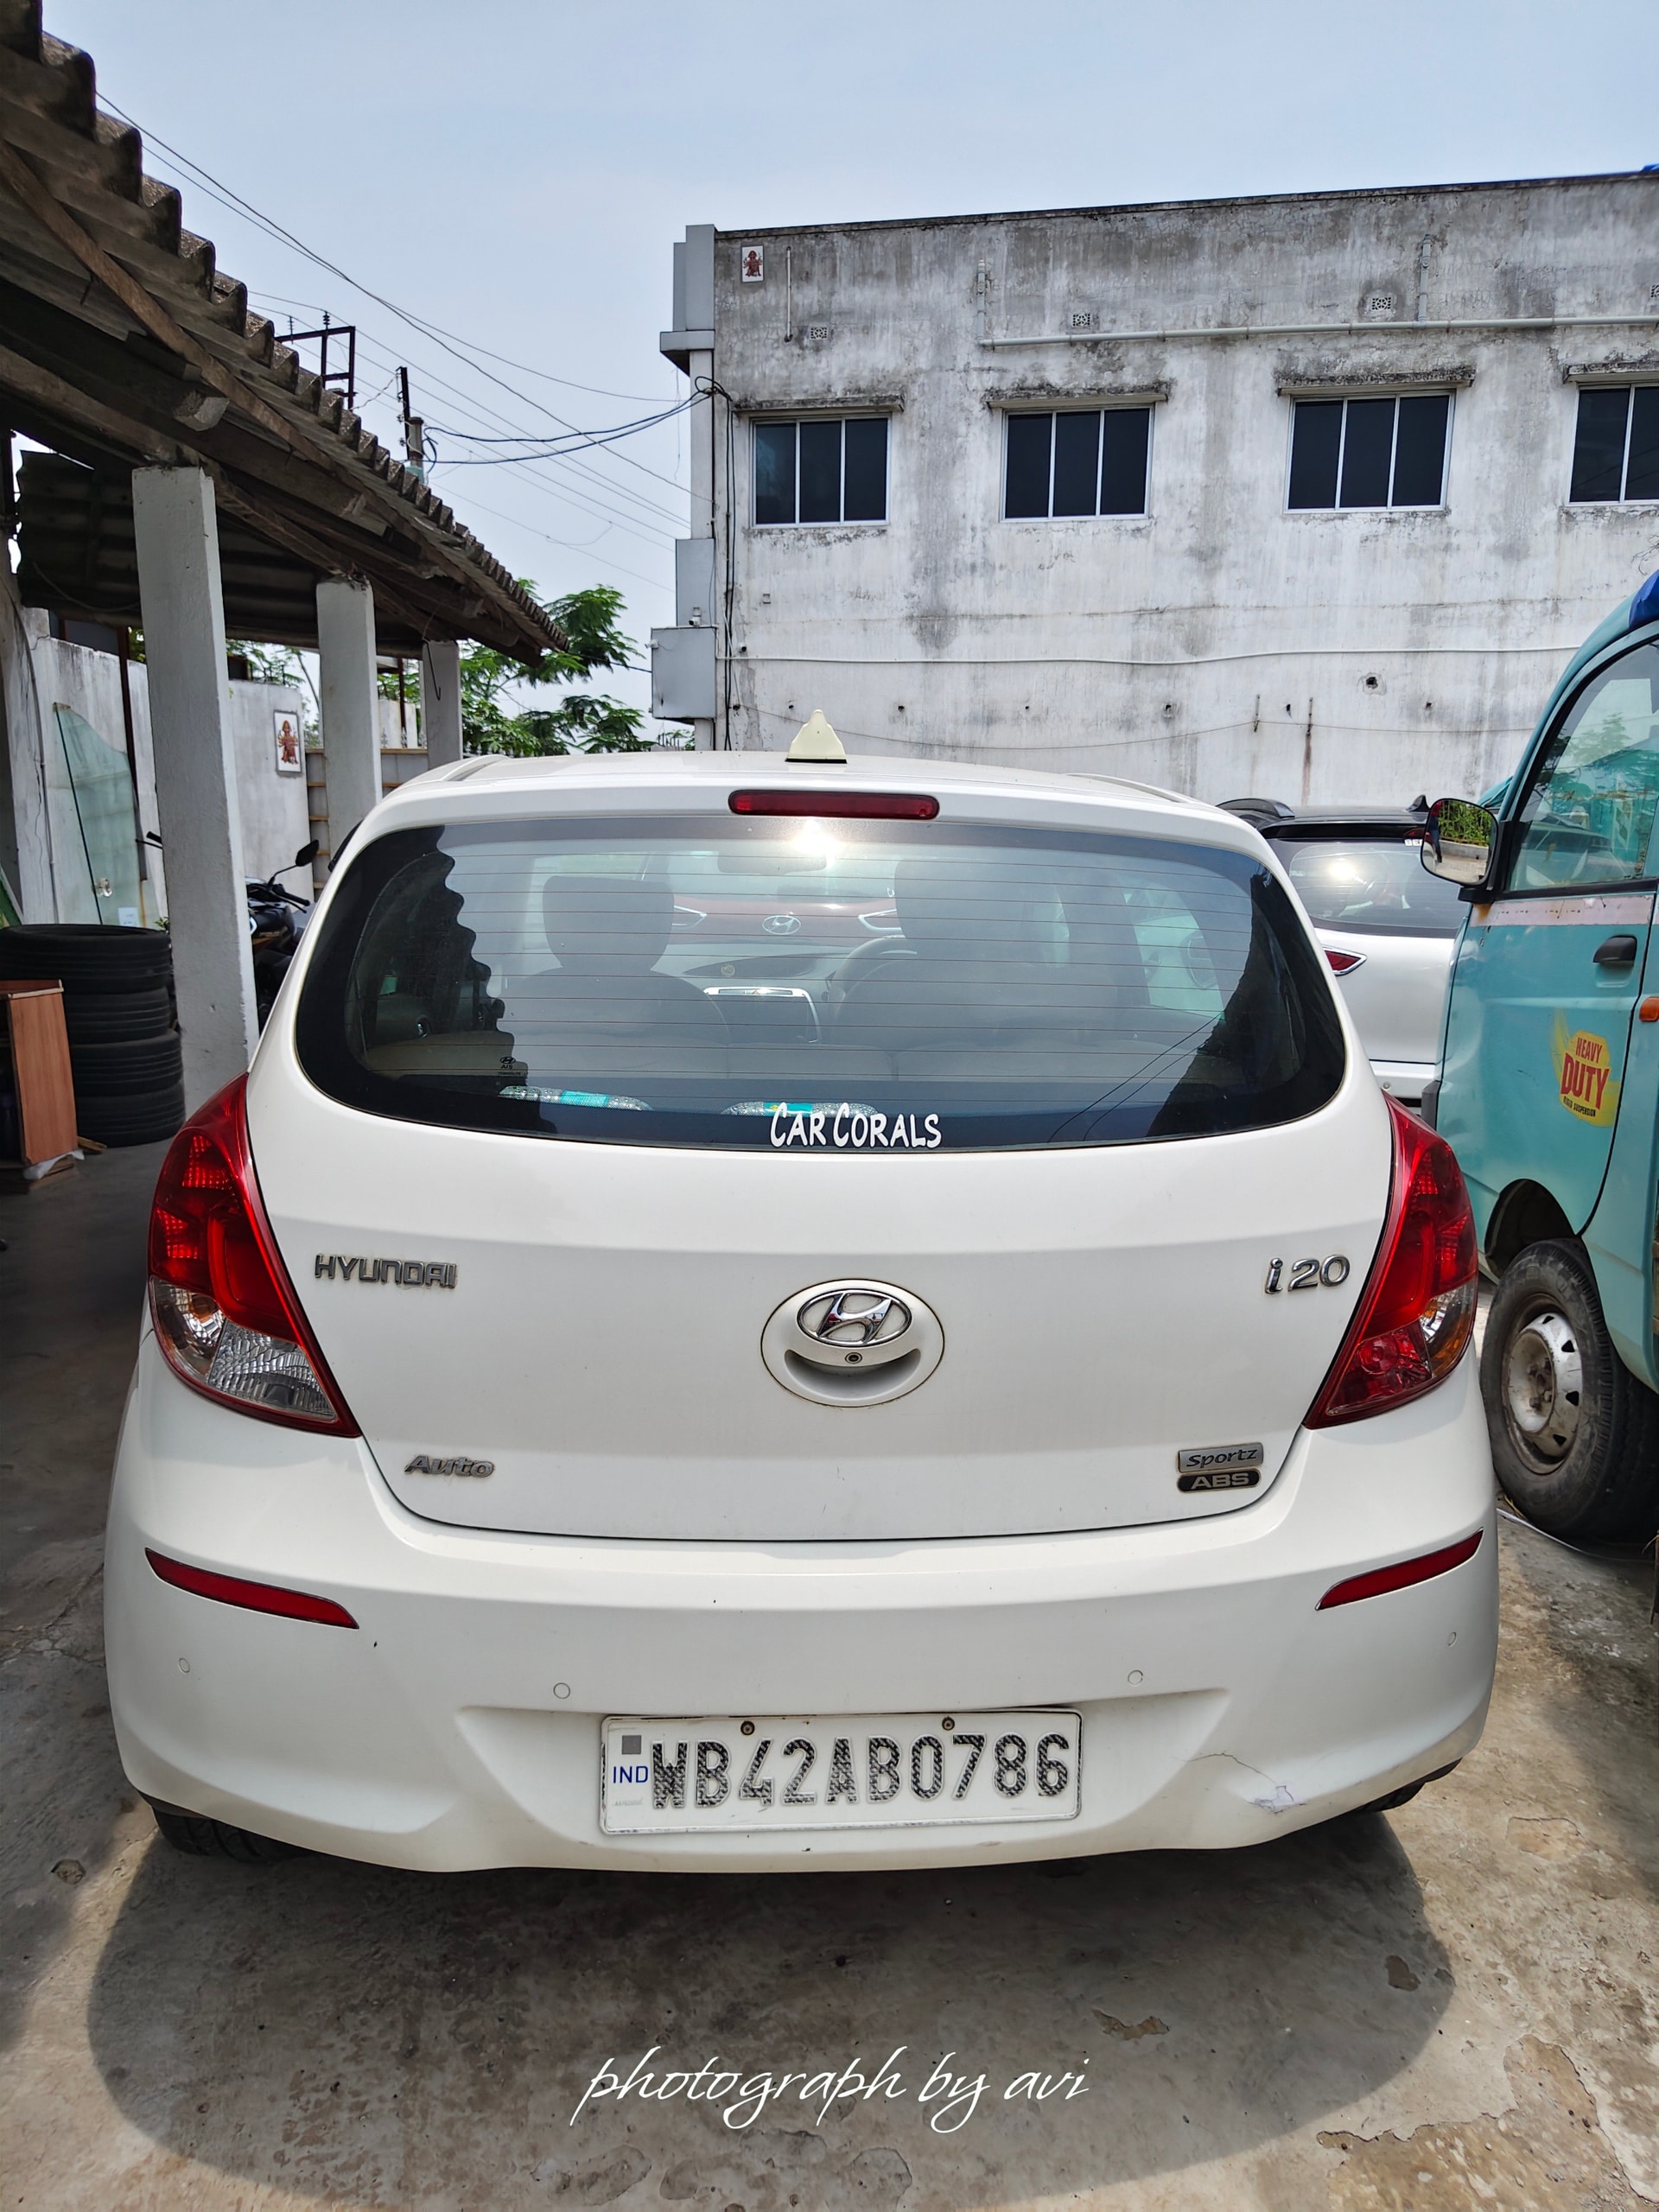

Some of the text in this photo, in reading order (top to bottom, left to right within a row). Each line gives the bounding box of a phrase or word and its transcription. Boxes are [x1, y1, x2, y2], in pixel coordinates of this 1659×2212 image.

[1575, 1037, 1603, 1064] HEAVY
[1560, 1052, 1610, 1110] DUTY
[770, 1102, 942, 1148] CAR CORALS
[315, 1254, 456, 1289] HYUNDAI
[404, 1455, 495, 1478] Auto
[1186, 1449, 1258, 1469] Sportz
[1191, 1472, 1249, 1490] ABS
[613, 1733, 1071, 1809] IND WB42AB0786
